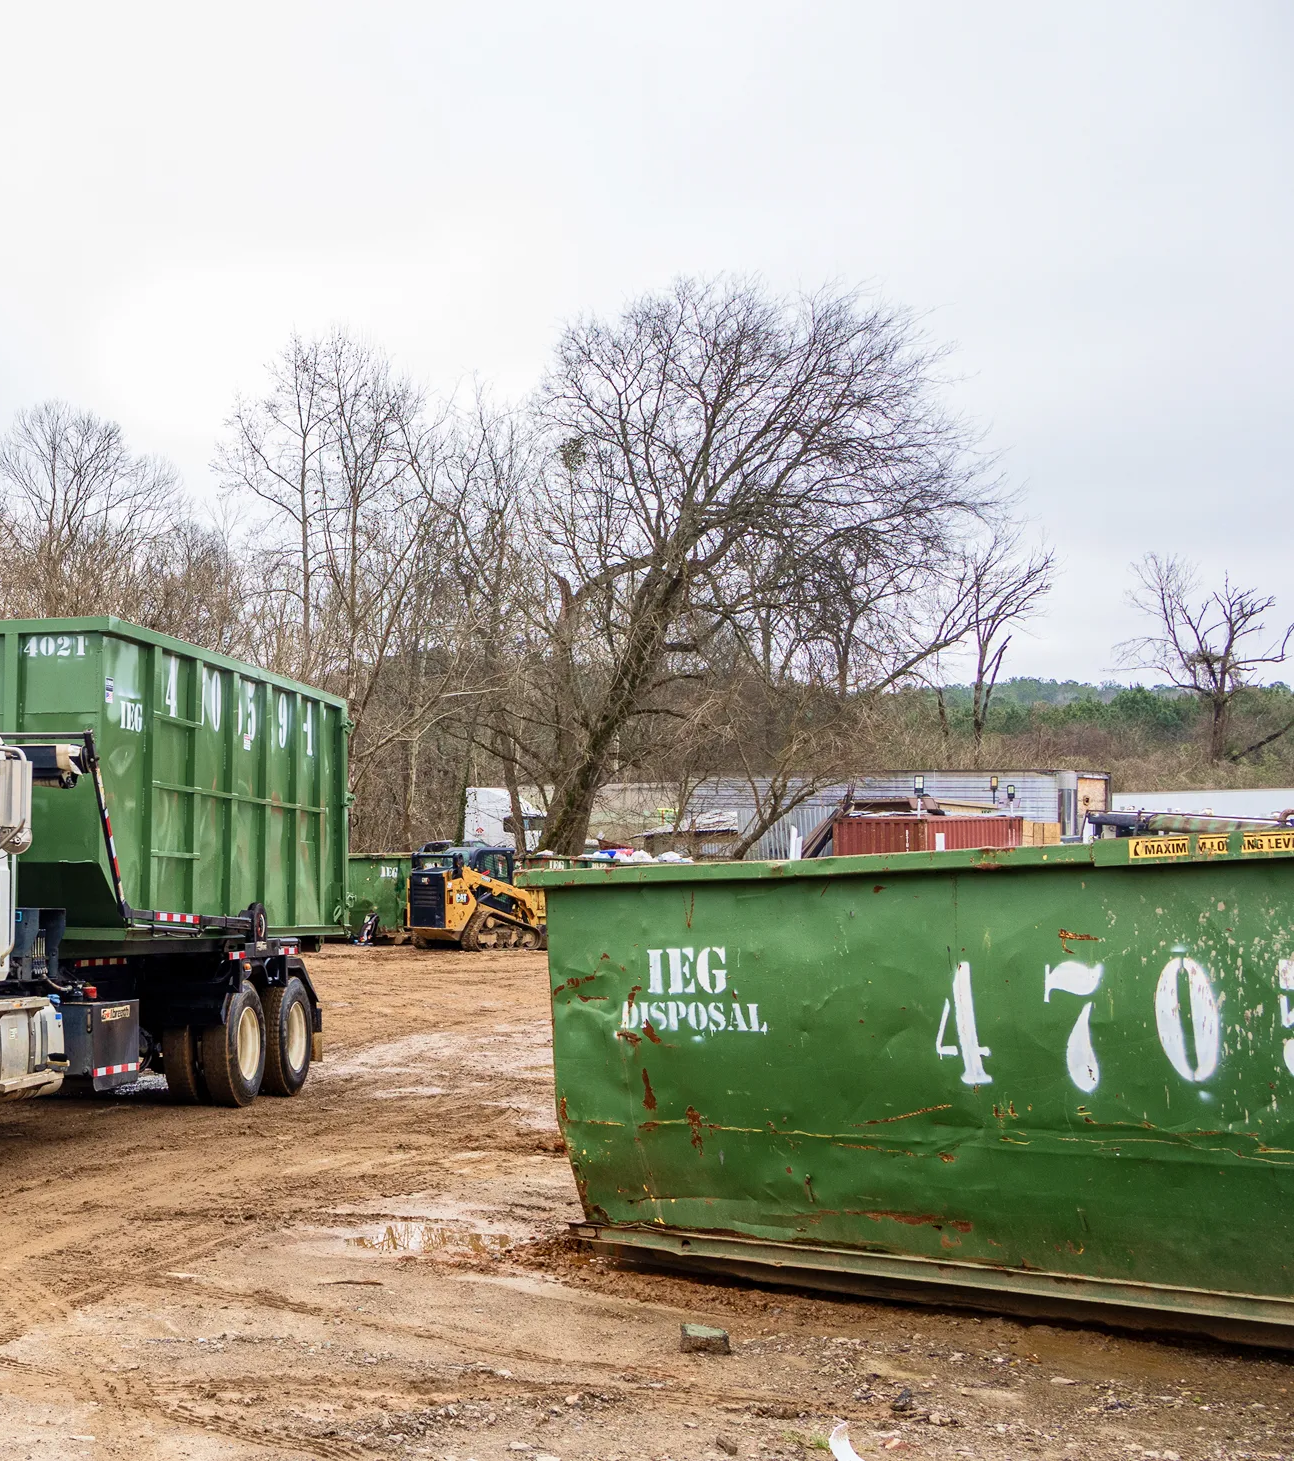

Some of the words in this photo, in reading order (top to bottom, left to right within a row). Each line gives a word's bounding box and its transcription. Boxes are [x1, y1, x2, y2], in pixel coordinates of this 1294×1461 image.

[24, 635, 86, 657] 4021
[120, 700, 143, 733] IEG
[1145, 843, 1206, 856] MAXIMM
[456, 893, 468, 903] CAT
[646, 946, 728, 995] IEG
[620, 1000, 769, 1034] DISPOSAL
[936, 956, 1294, 1092] 470
